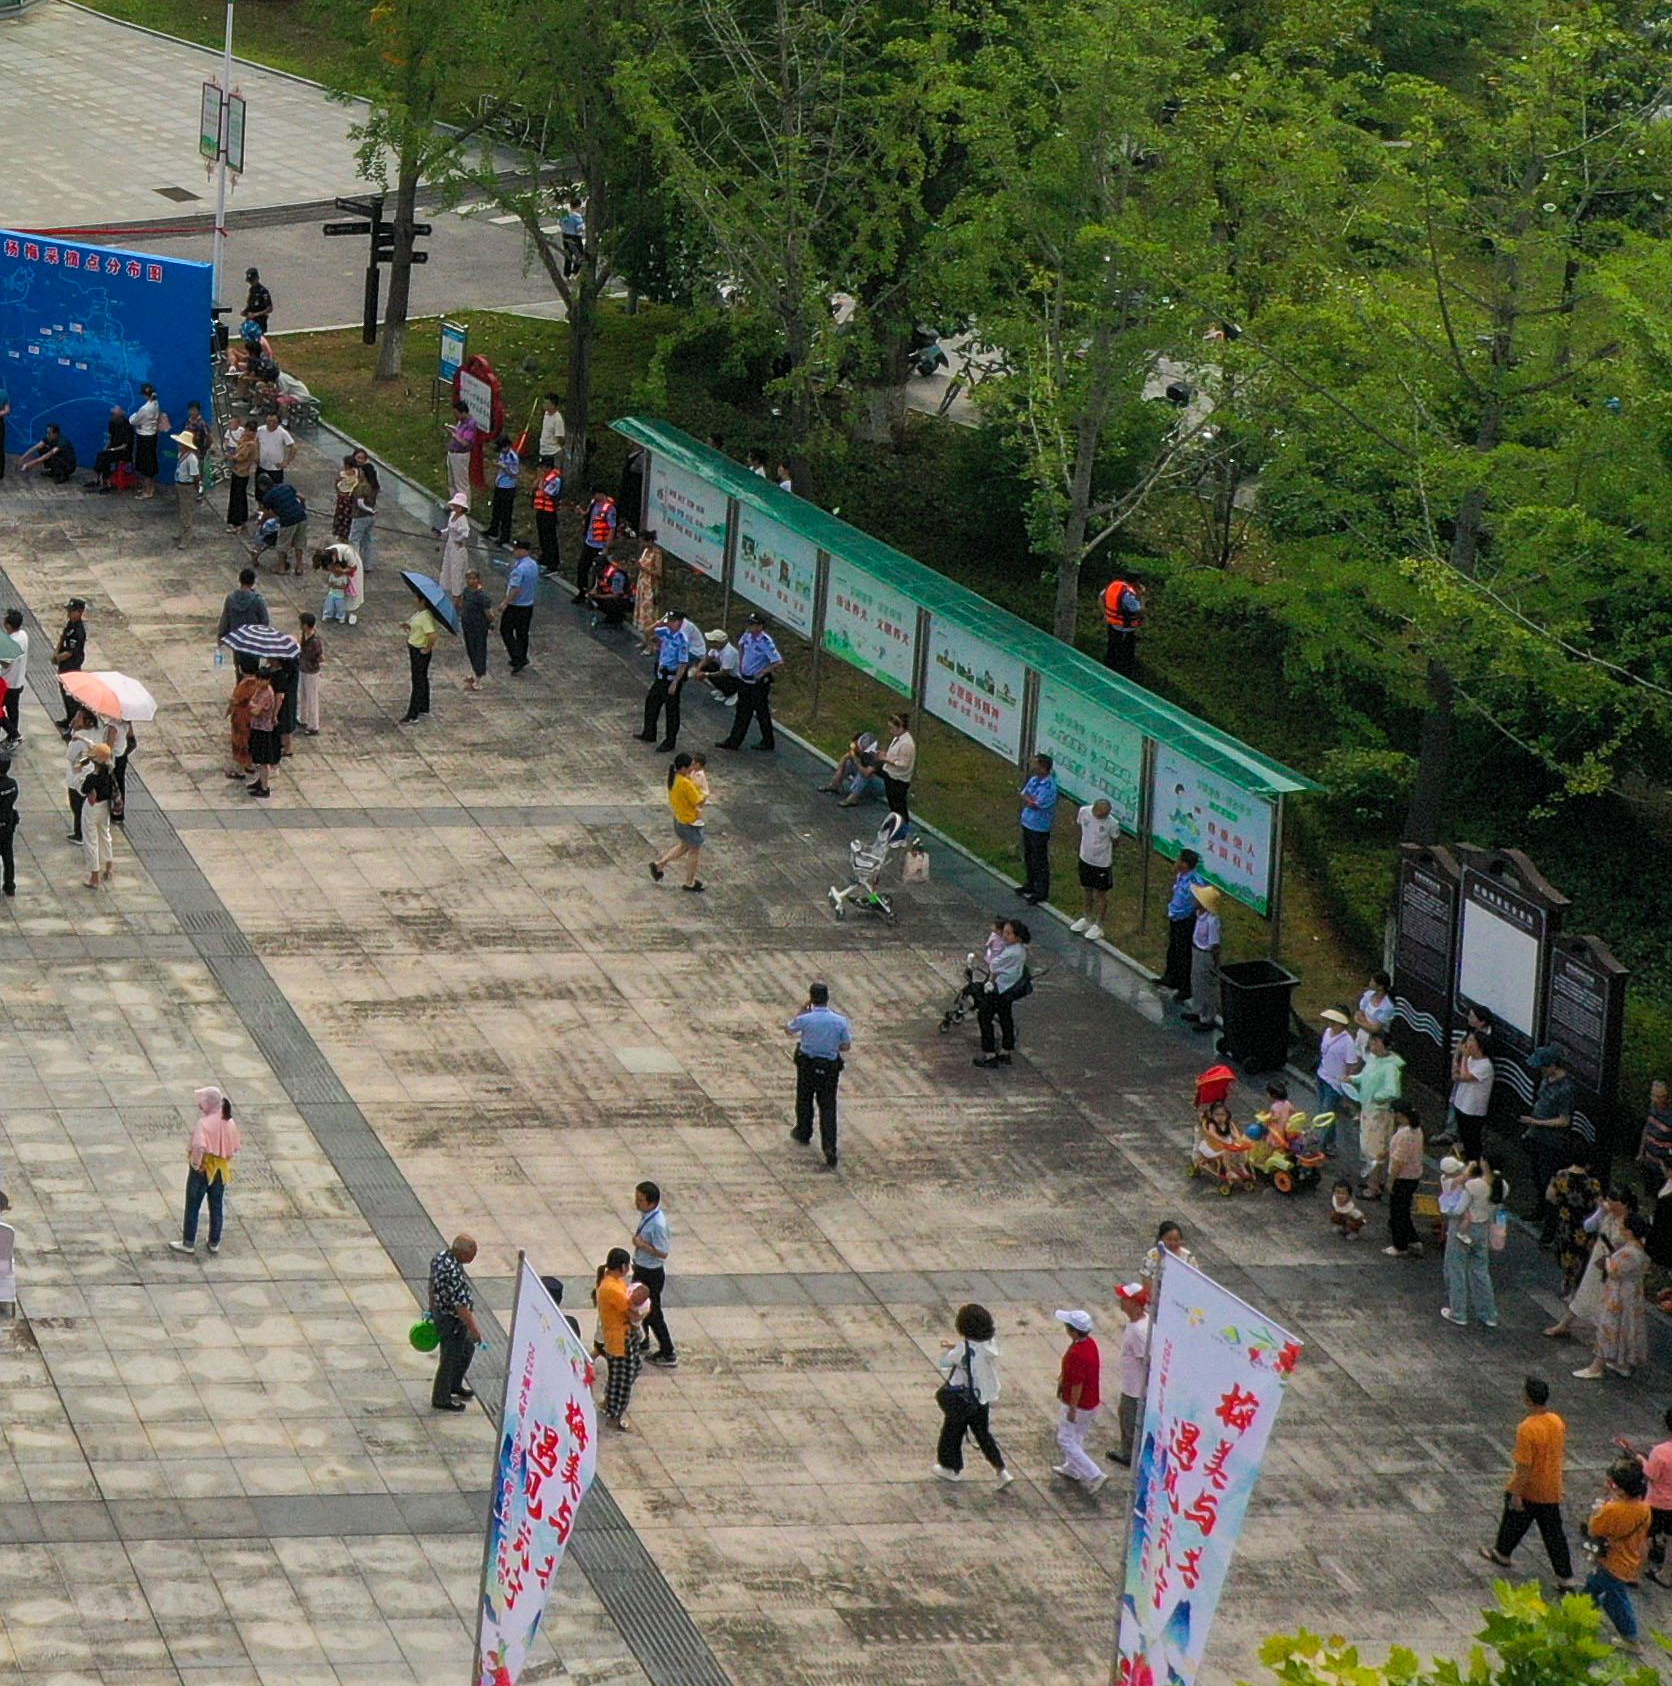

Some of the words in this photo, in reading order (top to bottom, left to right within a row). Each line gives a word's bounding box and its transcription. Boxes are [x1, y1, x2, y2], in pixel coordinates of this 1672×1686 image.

[3, 239, 163, 282] 杨梅采摘点分布图
[1152, 1416, 1201, 1611] 遇见武宁
[1176, 1380, 1261, 1590] 梅美与共
